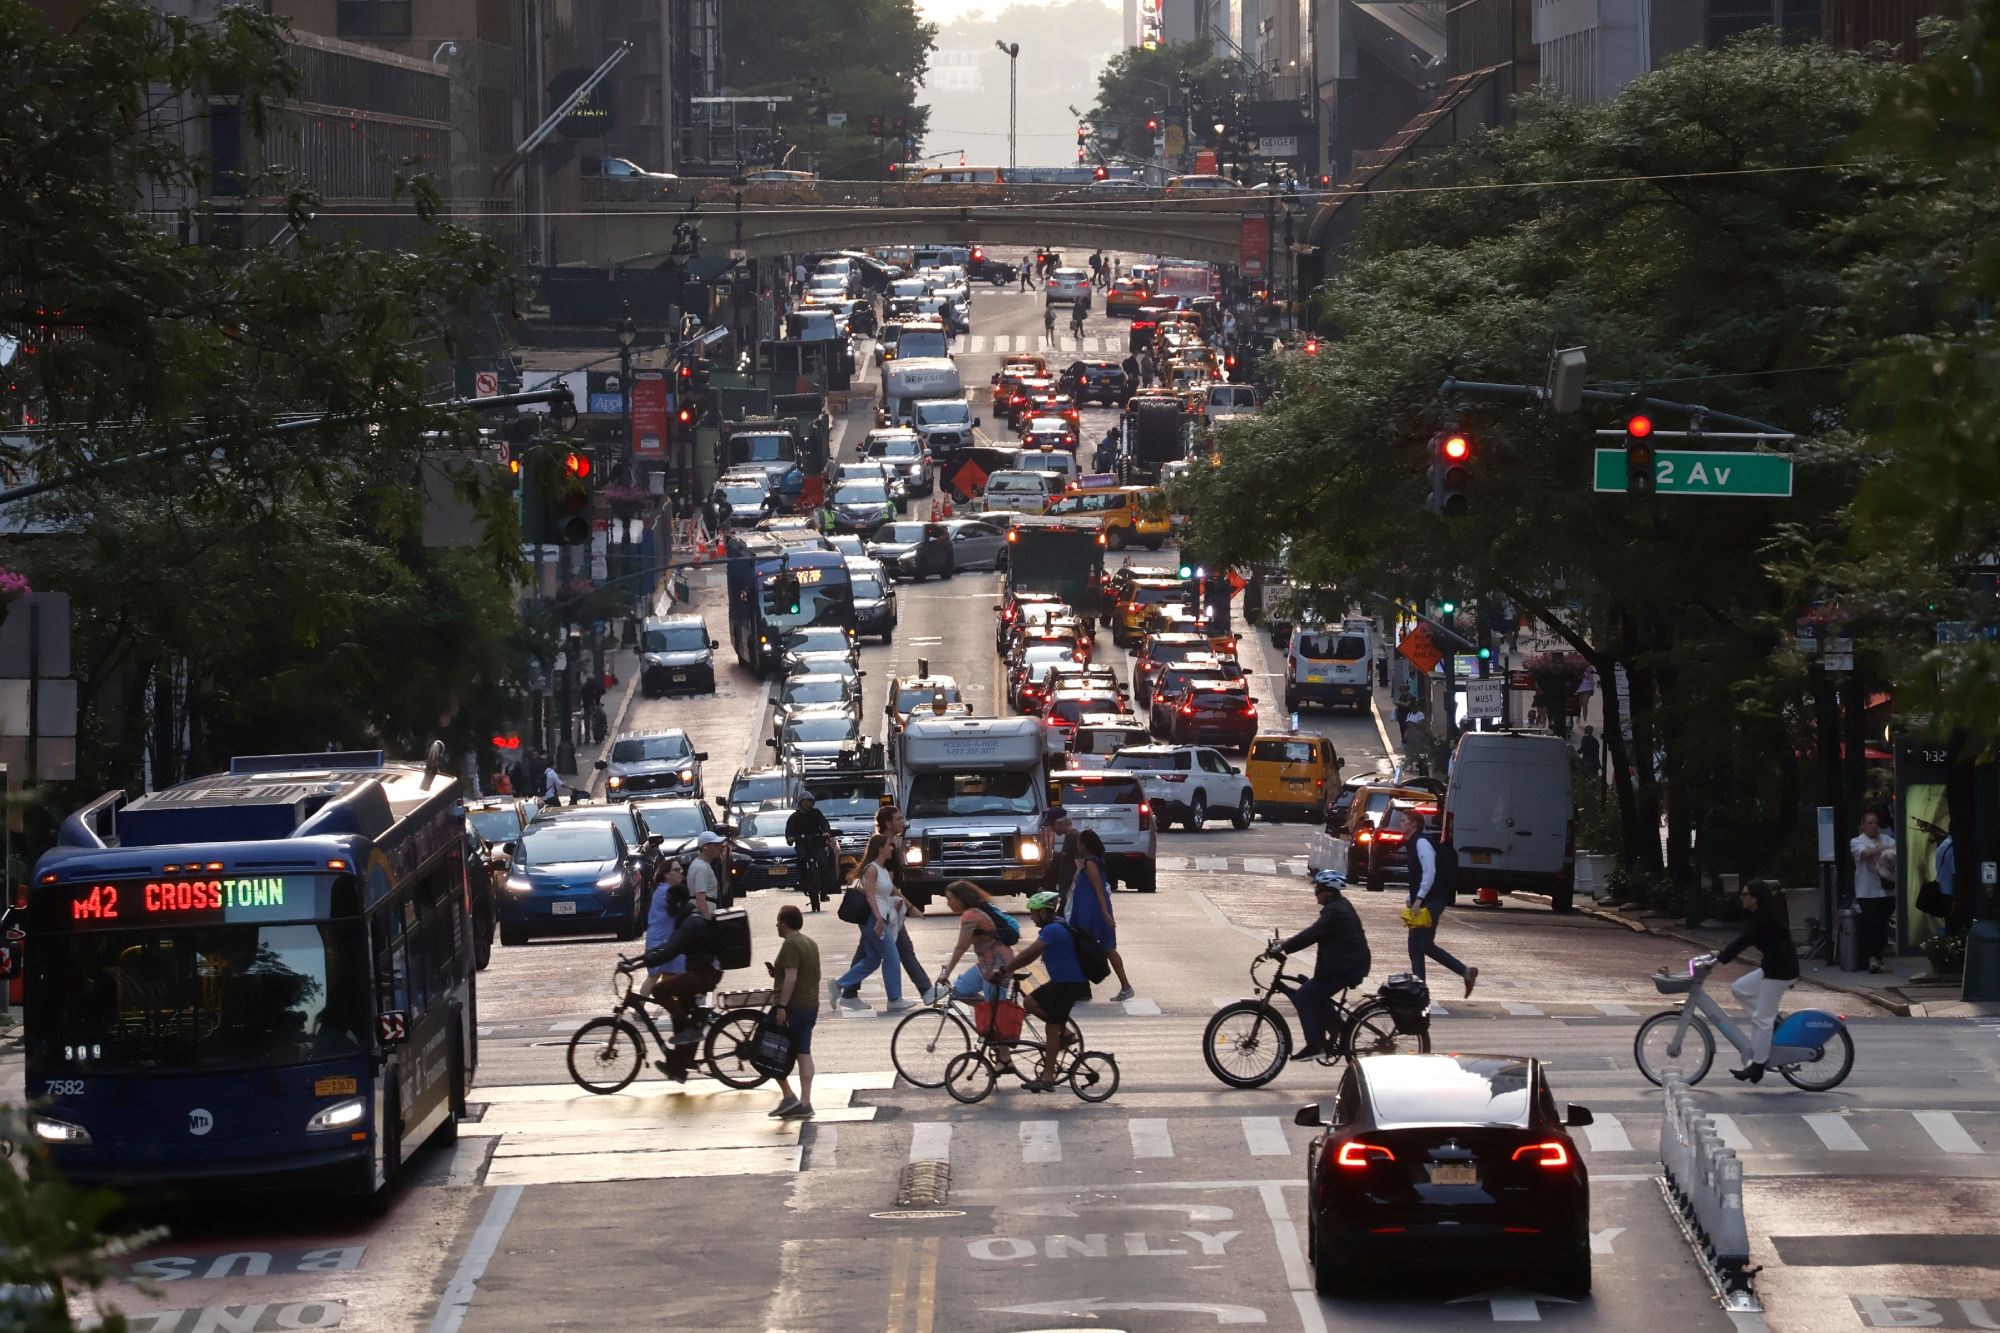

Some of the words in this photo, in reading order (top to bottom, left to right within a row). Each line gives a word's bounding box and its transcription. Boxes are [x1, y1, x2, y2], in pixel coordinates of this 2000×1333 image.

[1262, 138, 1296, 147] GEIGER
[595, 398, 623, 413] Appl
[1656, 461, 1674, 483] 2
[1687, 461, 1731, 485] Av
[1475, 695, 1493, 703] MUST
[74, 886, 118, 919] M42
[145, 878, 284, 911] CROSSTOWN
[46, 1079, 84, 1095] 7582
[966, 1230, 1243, 1261] ONLY
[127, 1246, 367, 1283] BUS
